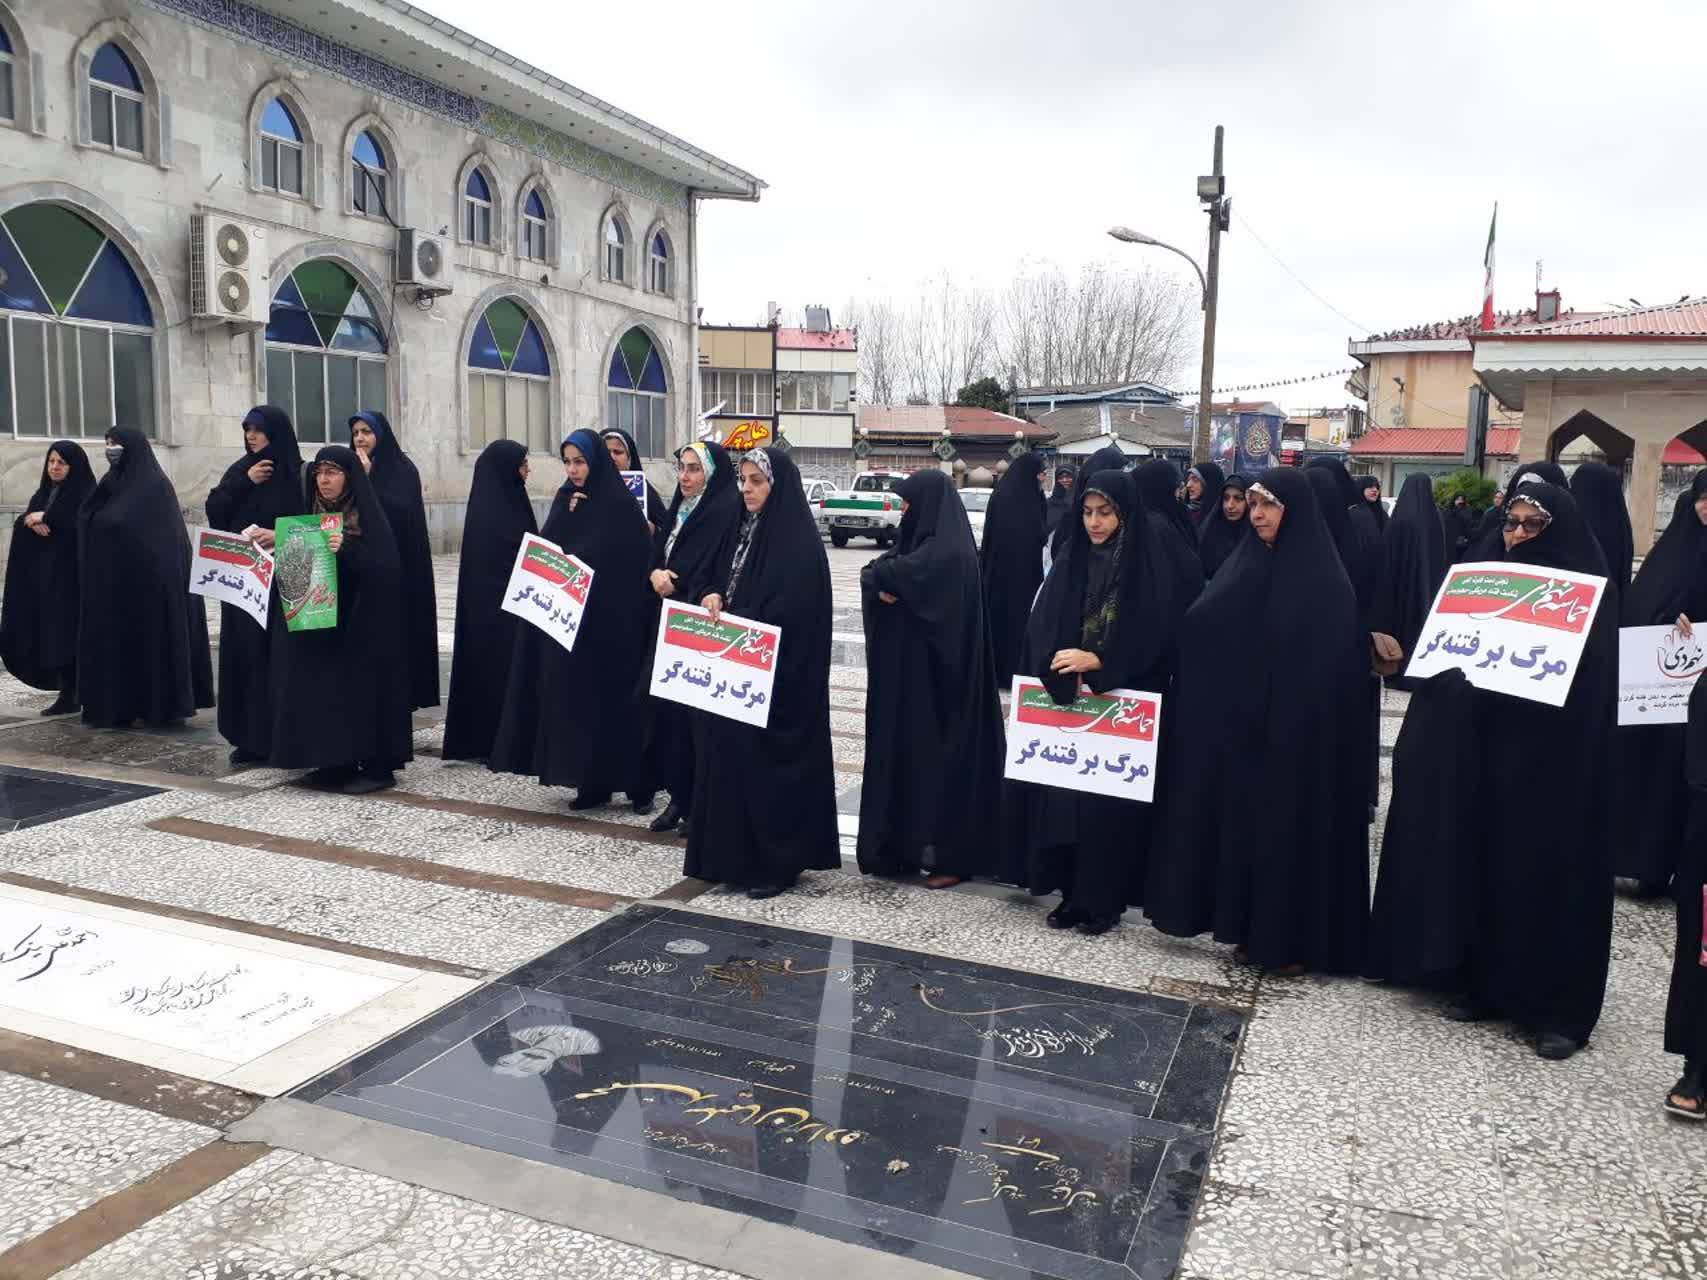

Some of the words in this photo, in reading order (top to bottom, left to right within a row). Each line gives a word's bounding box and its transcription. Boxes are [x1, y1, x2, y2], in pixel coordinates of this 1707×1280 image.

[548, 608, 561, 623] بر
[560, 612, 577, 633] مرگ
[1475, 645, 1504, 669] بر
[1510, 645, 1567, 681] مرگ
[1664, 646, 1688, 670] دی
[1682, 646, 1703, 672] نهم
[710, 679, 727, 699] بر
[730, 681, 766, 709] مرگ
[1078, 754, 1099, 775] بر
[1104, 753, 1149, 783] مرگ
